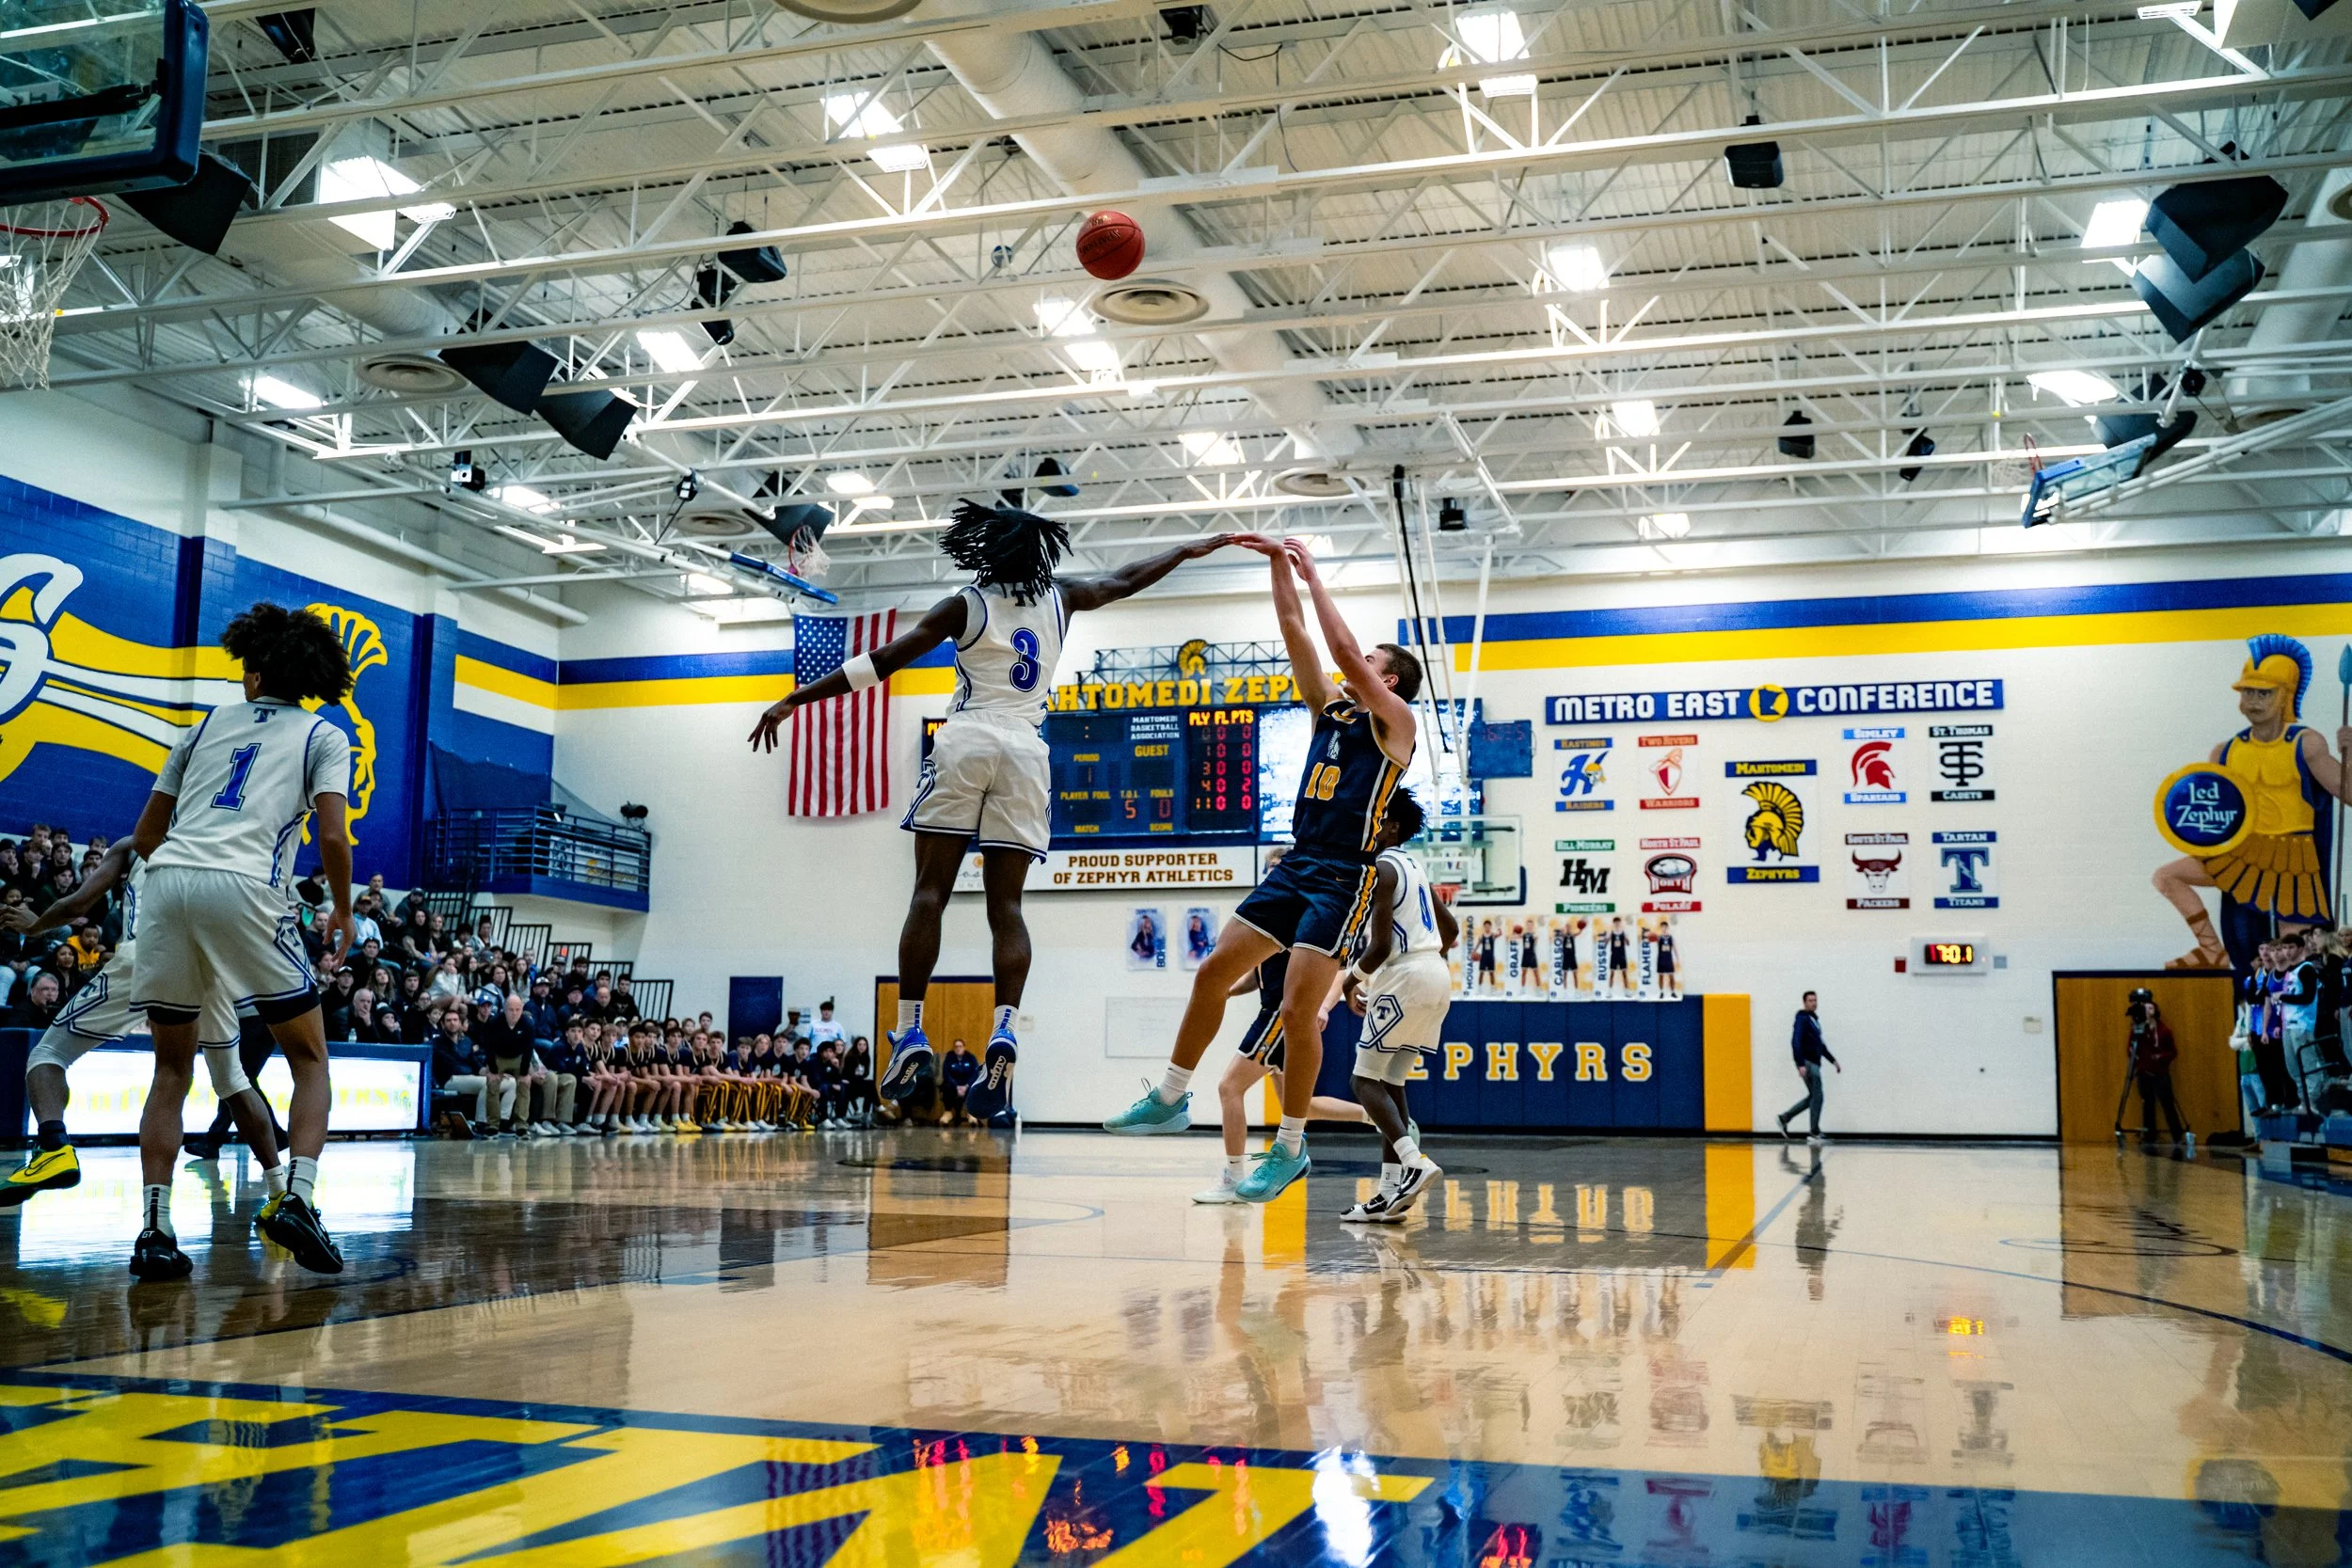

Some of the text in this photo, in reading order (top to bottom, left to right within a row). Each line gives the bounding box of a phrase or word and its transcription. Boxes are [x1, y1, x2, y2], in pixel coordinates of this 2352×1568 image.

[1009, 627, 1041, 691] 3
[1048, 678, 1211, 712] HTOMEDI
[1555, 681, 1994, 721] METRO EAST CONFERENCE
[254, 707, 278, 723] T
[1189, 710, 1254, 725] PLY FL PTS
[1131, 723, 1180, 732] BASKETBALL
[1852, 728, 1899, 737] SIMLEY
[1131, 732, 1180, 740] ASSOCIATION
[1663, 736, 1694, 745] RIVERS
[1135, 744, 1169, 757] GUEST
[1216, 743, 1226, 757] 0
[1242, 742, 1251, 757] 0
[1561, 739, 1606, 749] HASTINGS
[1203, 760, 1251, 775] 3 0 0
[1736, 762, 1806, 775] MAHTOMEDI
[211, 743, 262, 811] 1
[1305, 763, 1341, 800] 10
[1201, 777, 1251, 793] 4 0 2
[1150, 788, 1174, 798] FOULS
[1850, 792, 1901, 802] SPARTANS
[1943, 791, 1982, 800] CADETS
[2188, 782, 2220, 805] Led
[1124, 799, 1136, 818] 5
[1159, 798, 1170, 818] 0
[1196, 795, 1251, 810] 11 0 0
[1565, 800, 1605, 810] RAIDERS
[1645, 799, 1694, 808] WARRIORS
[2176, 805, 2238, 833] Zephyr
[1941, 832, 1987, 842] TARTAN
[1069, 853, 1217, 868] PROUD SUPPORTER
[1054, 869, 1233, 884] OF ZEPHYR ATHLETICS
[1560, 859, 1611, 894] HM
[1746, 867, 1800, 880] ZEPHYRS
[1941, 847, 1990, 893] T
[1651, 876, 1691, 892] NORTH
[1419, 884, 1434, 932] 0
[1563, 903, 1608, 912] PIONEERS
[1856, 898, 1900, 908] PACKERS
[1947, 897, 1985, 907] TITANS
[1510, 942, 1518, 977] GRAFF
[1554, 929, 1563, 986] CARLSON
[1642, 927, 1651, 985] FLAHERTY
[1376, 1006, 1391, 1020] T
[141, 1230, 155, 1239] GT
